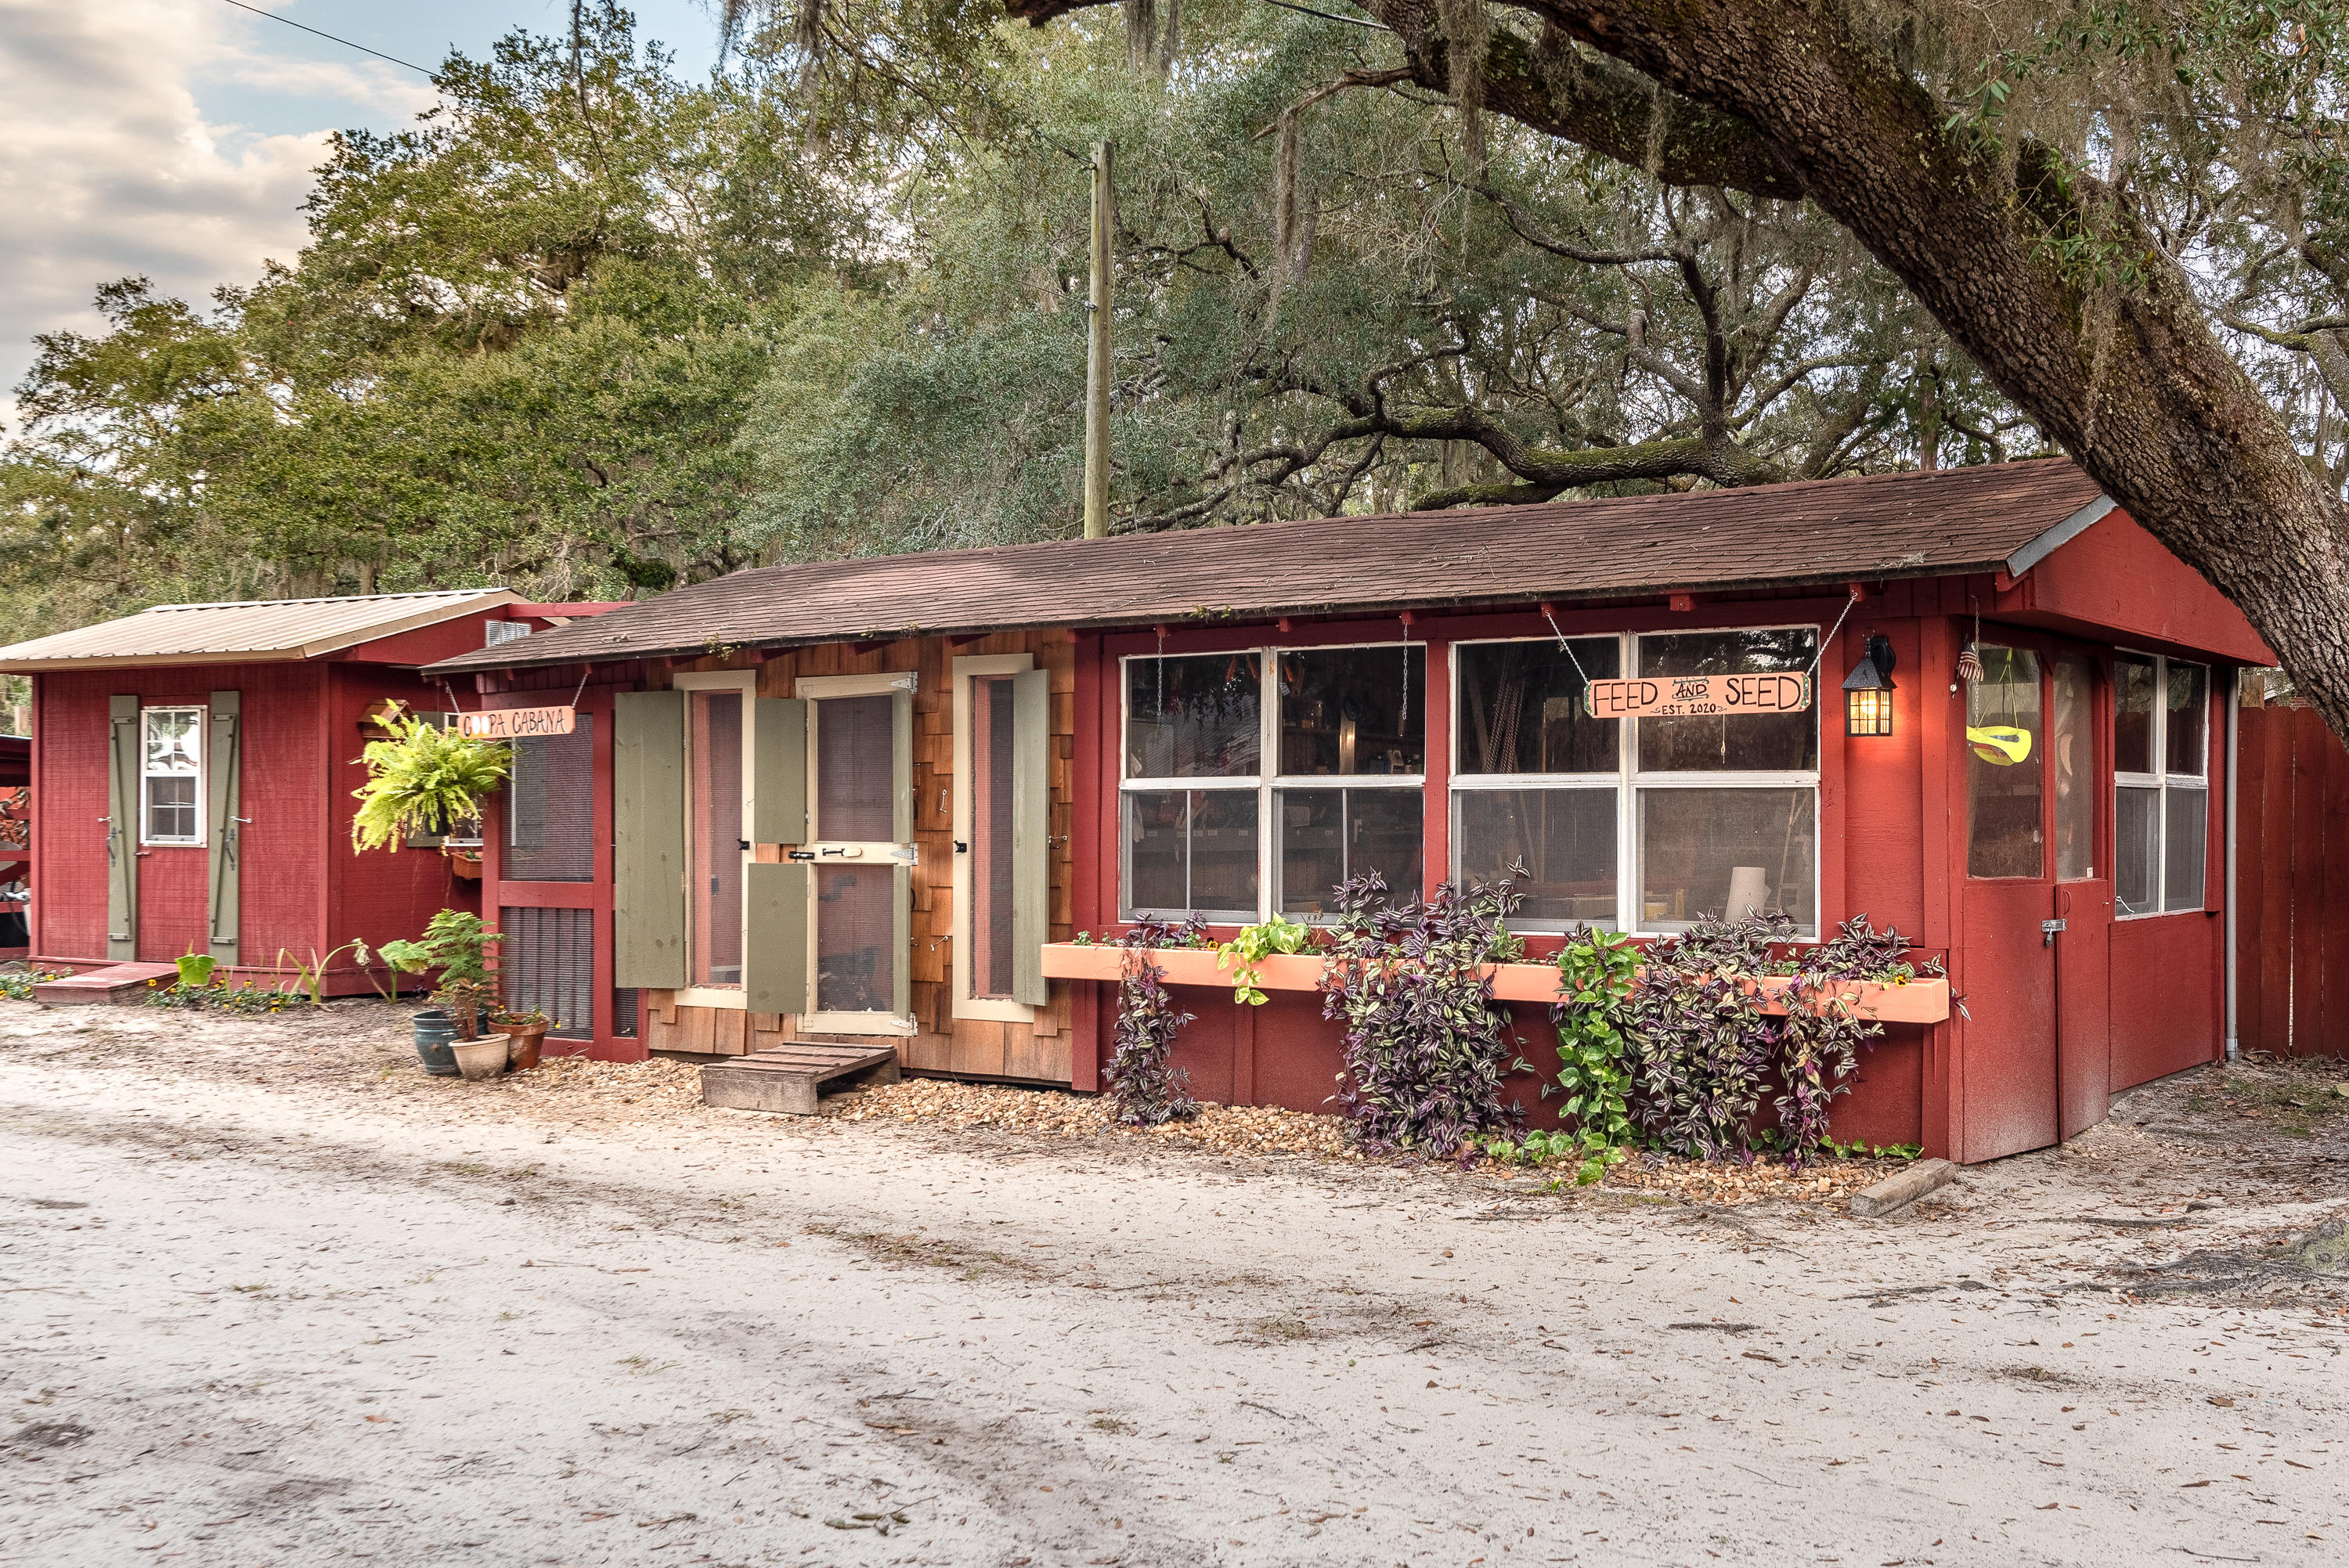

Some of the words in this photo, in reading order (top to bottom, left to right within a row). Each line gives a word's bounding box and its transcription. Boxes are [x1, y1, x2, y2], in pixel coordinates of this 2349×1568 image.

[1593, 681, 1658, 716] FEED
[1675, 683, 1707, 697] AND
[1725, 676, 1801, 710] SEED
[513, 708, 565, 734] CABANA
[1662, 705, 1685, 715] EST.
[1690, 704, 1716, 714] 2020
